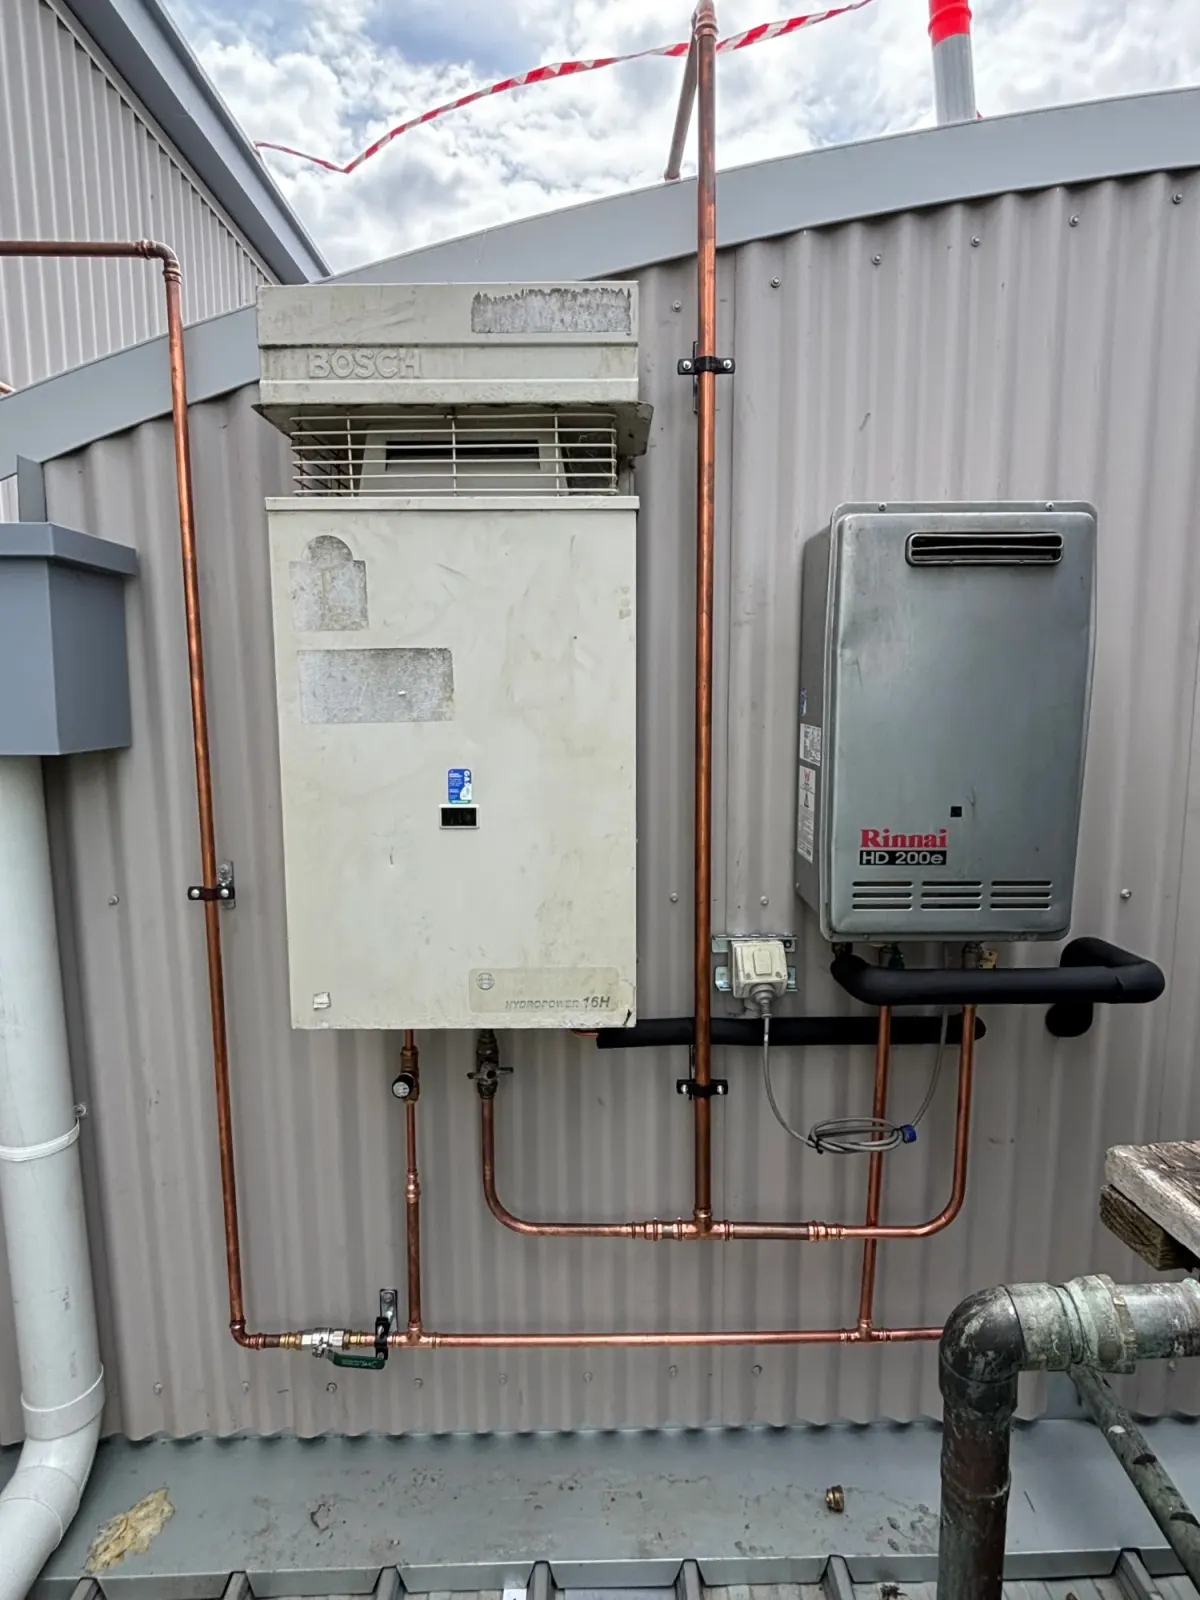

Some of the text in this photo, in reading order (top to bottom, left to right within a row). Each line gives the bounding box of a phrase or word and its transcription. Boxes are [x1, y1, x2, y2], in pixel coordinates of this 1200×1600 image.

[307, 347, 421, 379] BOSCH
[860, 828, 947, 848] Rinnai
[862, 851, 944, 864] HD 200e
[583, 996, 611, 1008] 16H
